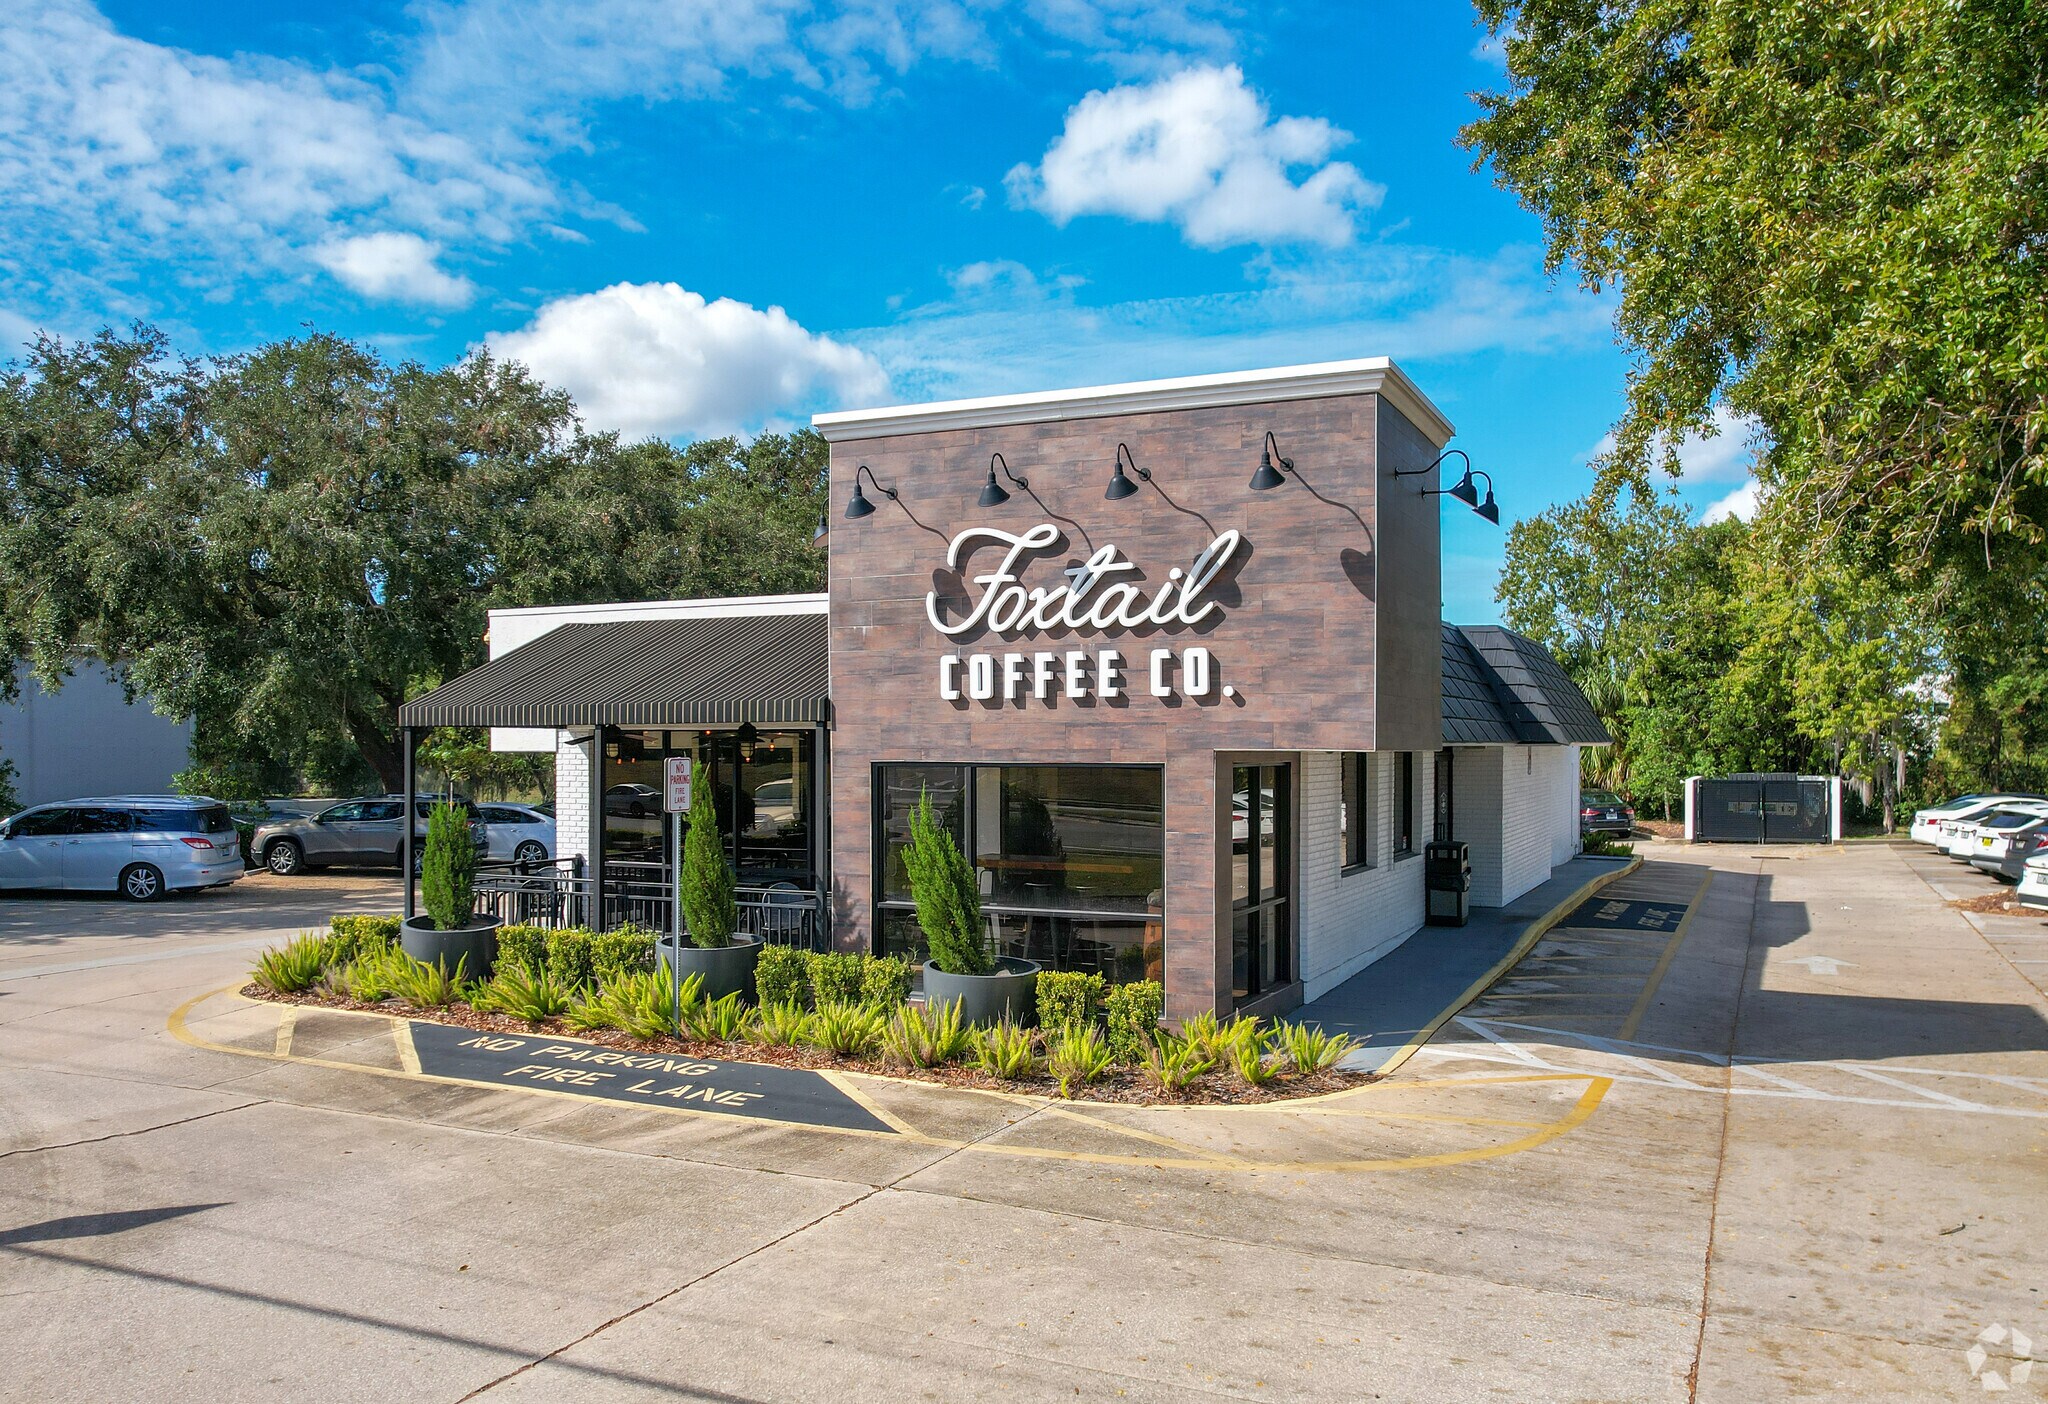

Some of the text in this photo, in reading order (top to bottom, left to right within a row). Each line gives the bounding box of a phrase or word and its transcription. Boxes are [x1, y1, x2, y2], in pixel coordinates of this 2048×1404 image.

[926, 523, 1241, 635] Foxtail
[940, 647, 1236, 700] COFFEE CO.
[670, 774, 690, 785] PARKING
[676, 763, 684, 774] NO
[675, 796, 685, 804] LANE
[457, 1035, 718, 1077] NO PARKING
[502, 1065, 766, 1107] FIRE LANE
